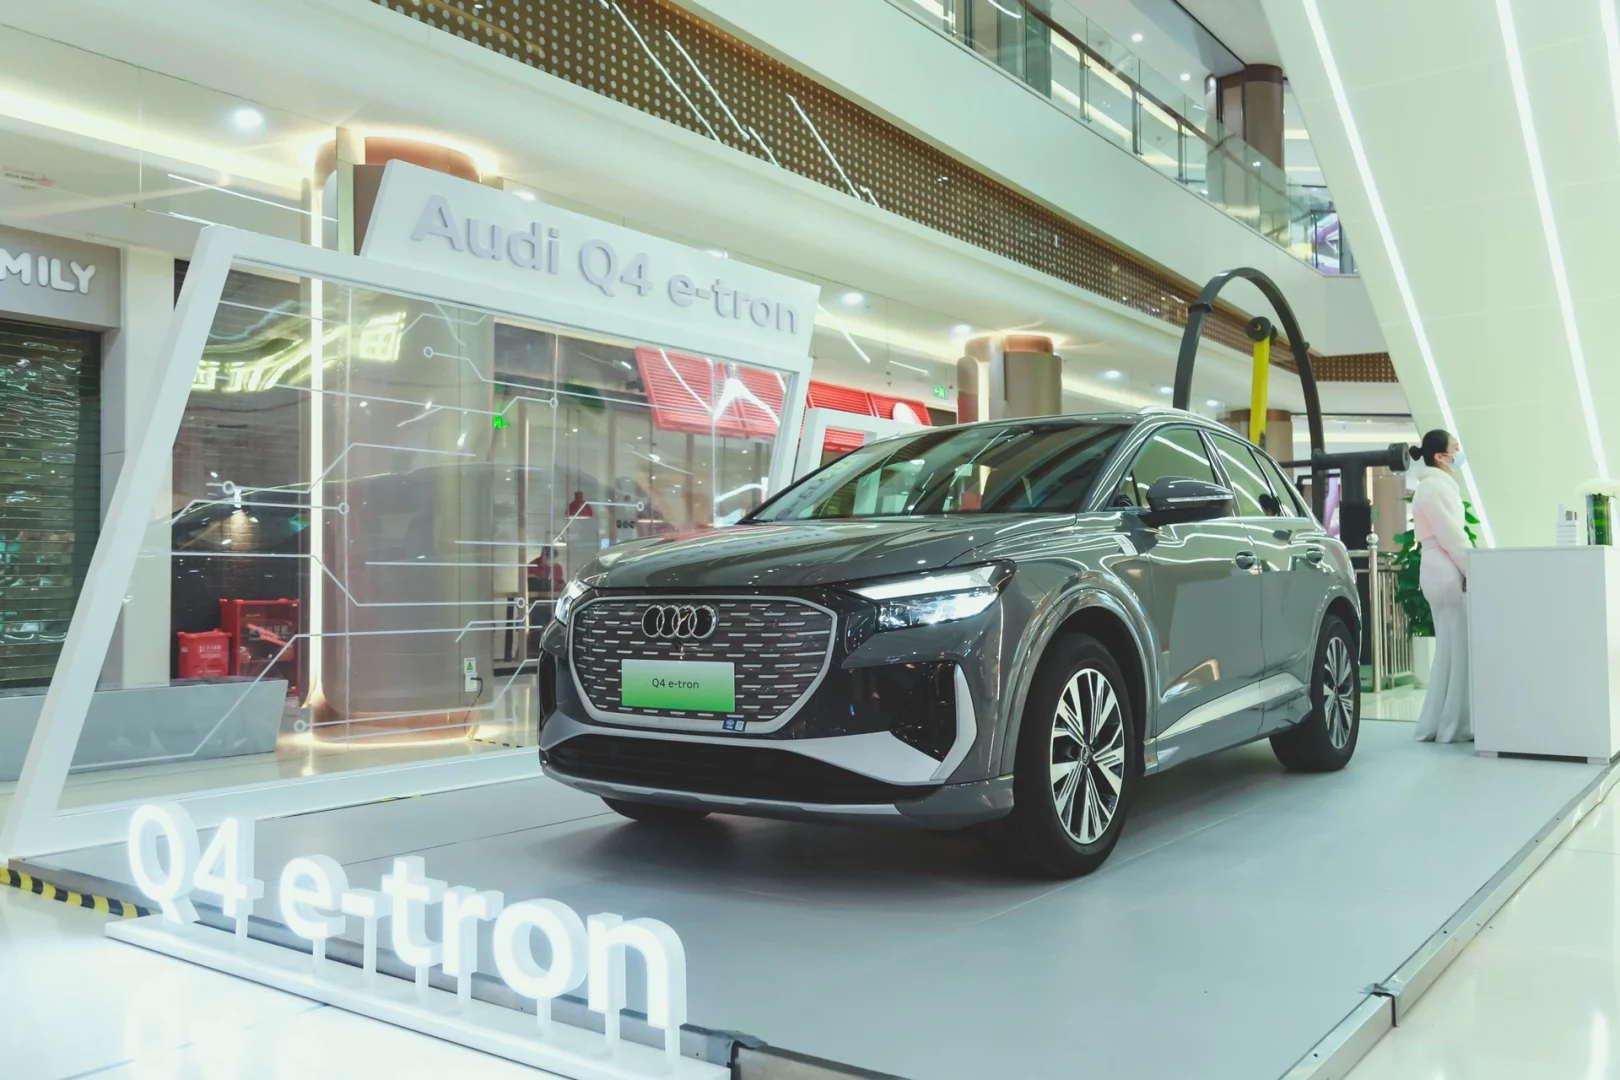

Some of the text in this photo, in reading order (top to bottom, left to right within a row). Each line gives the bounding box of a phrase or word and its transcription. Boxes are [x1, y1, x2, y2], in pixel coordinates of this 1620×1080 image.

[410, 194, 799, 334] Audi Q4 e-tron
[652, 678, 700, 690] Q4 e-tron
[129, 803, 687, 1029] Q4 e-tron
